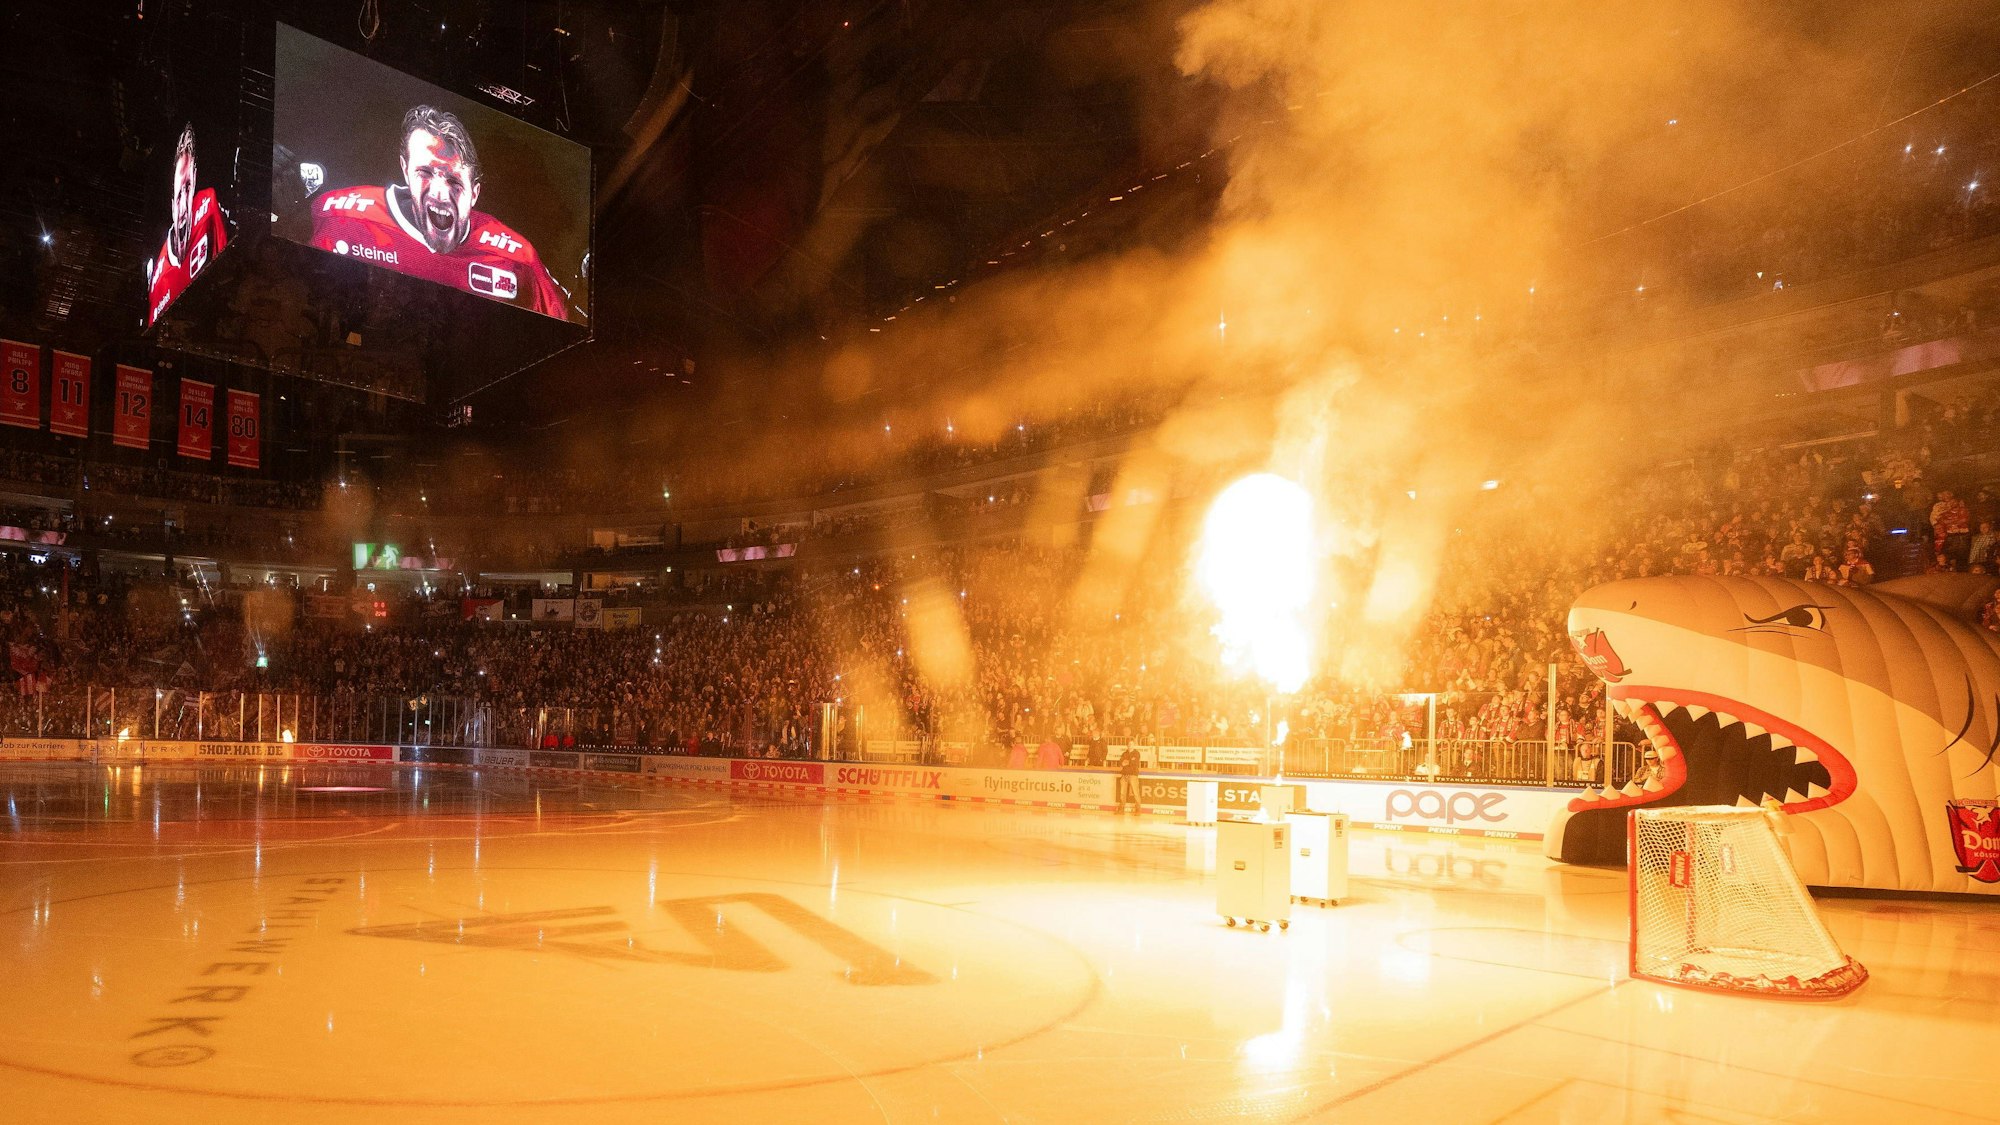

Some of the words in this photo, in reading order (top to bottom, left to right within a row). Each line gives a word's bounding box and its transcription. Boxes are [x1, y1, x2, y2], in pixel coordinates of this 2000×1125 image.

[351, 243, 399, 264] steinel
[10, 367, 30, 395] 8
[58, 377, 85, 407] 11
[119, 390, 148, 419] 12
[184, 403, 209, 431] 14
[229, 413, 257, 440] 80
[32, 742, 65, 750] Karriere
[198, 744, 284, 756] SHOP.HAIE.DE
[328, 747, 372, 758] TOYOTA
[762, 764, 809, 780] TOYOTA
[837, 767, 943, 789] SCHÜTTFLIX
[984, 775, 1073, 794] flyingcircus.io
[1141, 782, 1187, 801] RÖSS
[1224, 789, 1262, 804] STA
[1386, 789, 1508, 825] pape
